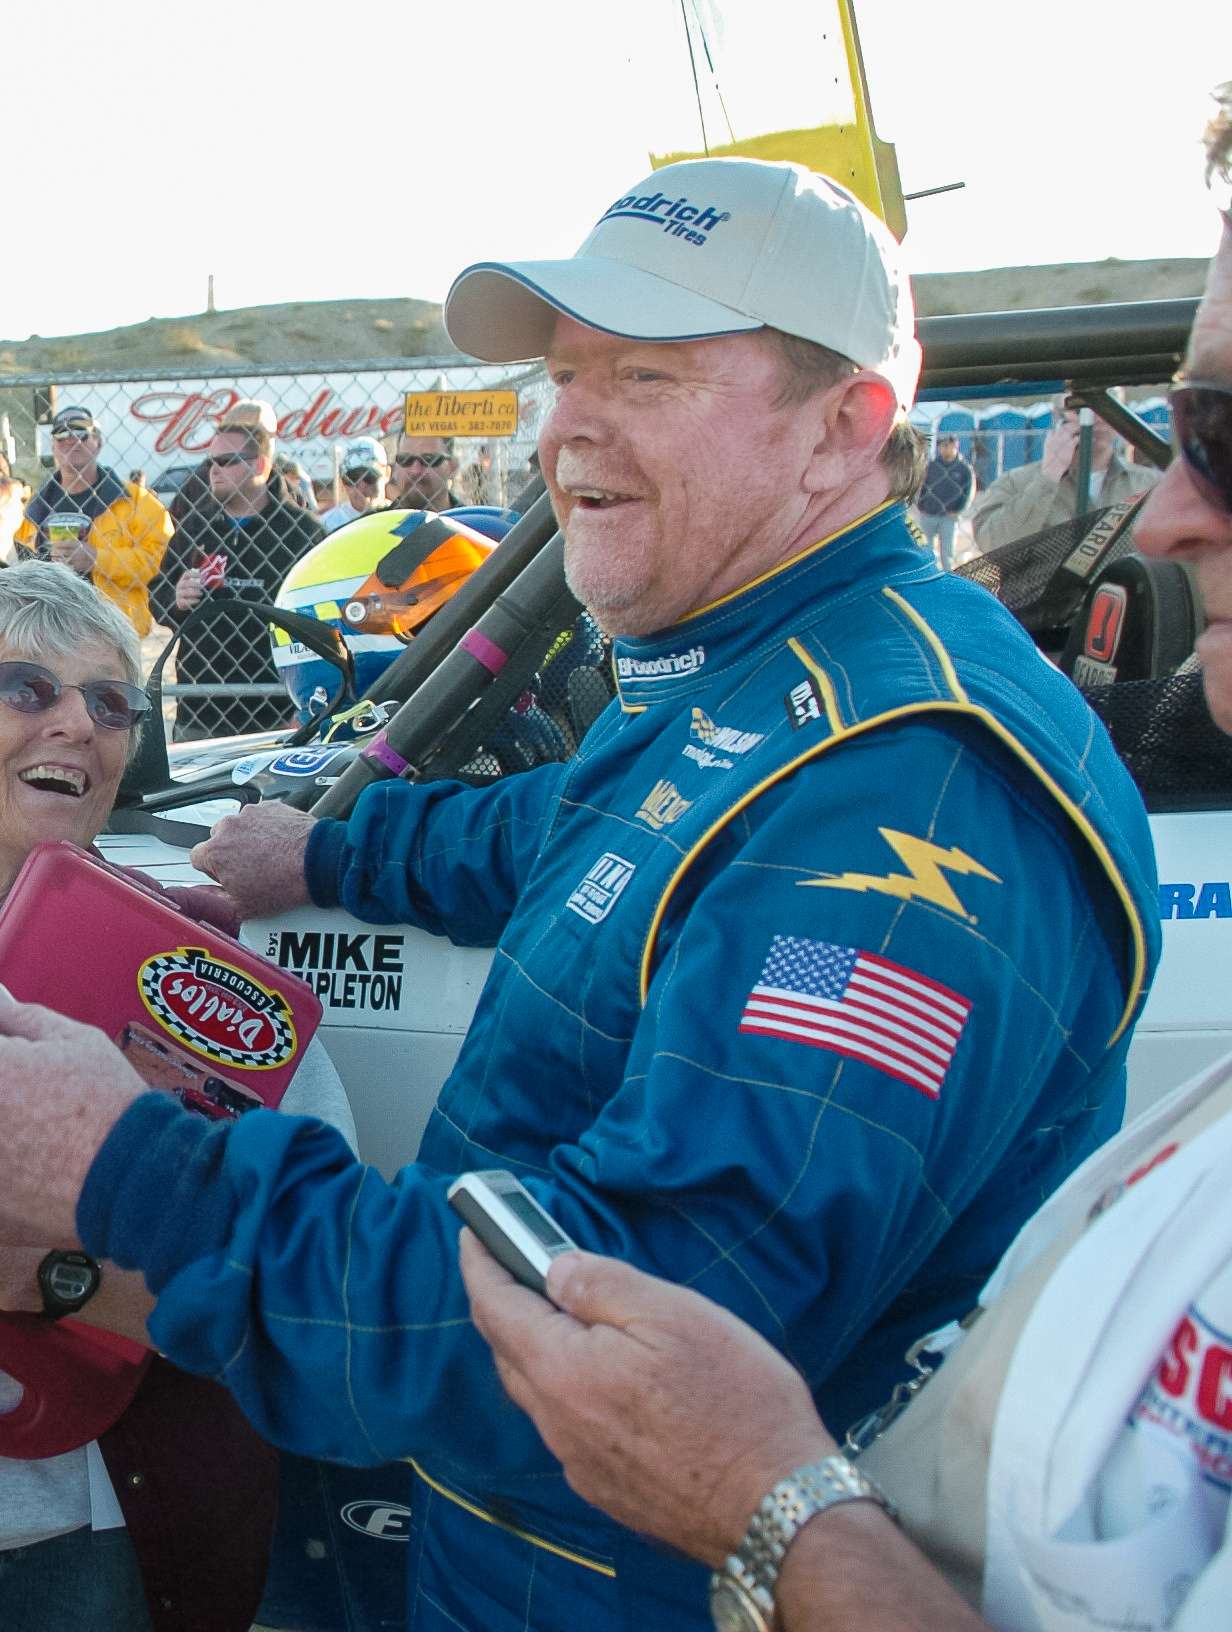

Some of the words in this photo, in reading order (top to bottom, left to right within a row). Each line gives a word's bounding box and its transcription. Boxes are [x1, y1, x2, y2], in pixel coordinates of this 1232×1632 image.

[663, 218, 707, 246] Tires
[408, 400, 432, 417] the
[410, 422, 427, 432] LAS
[429, 420, 458, 432] VEGAS
[266, 932, 278, 956] by:
[279, 931, 405, 973] MIKE
[199, 961, 267, 1008] ESCUDERIA
